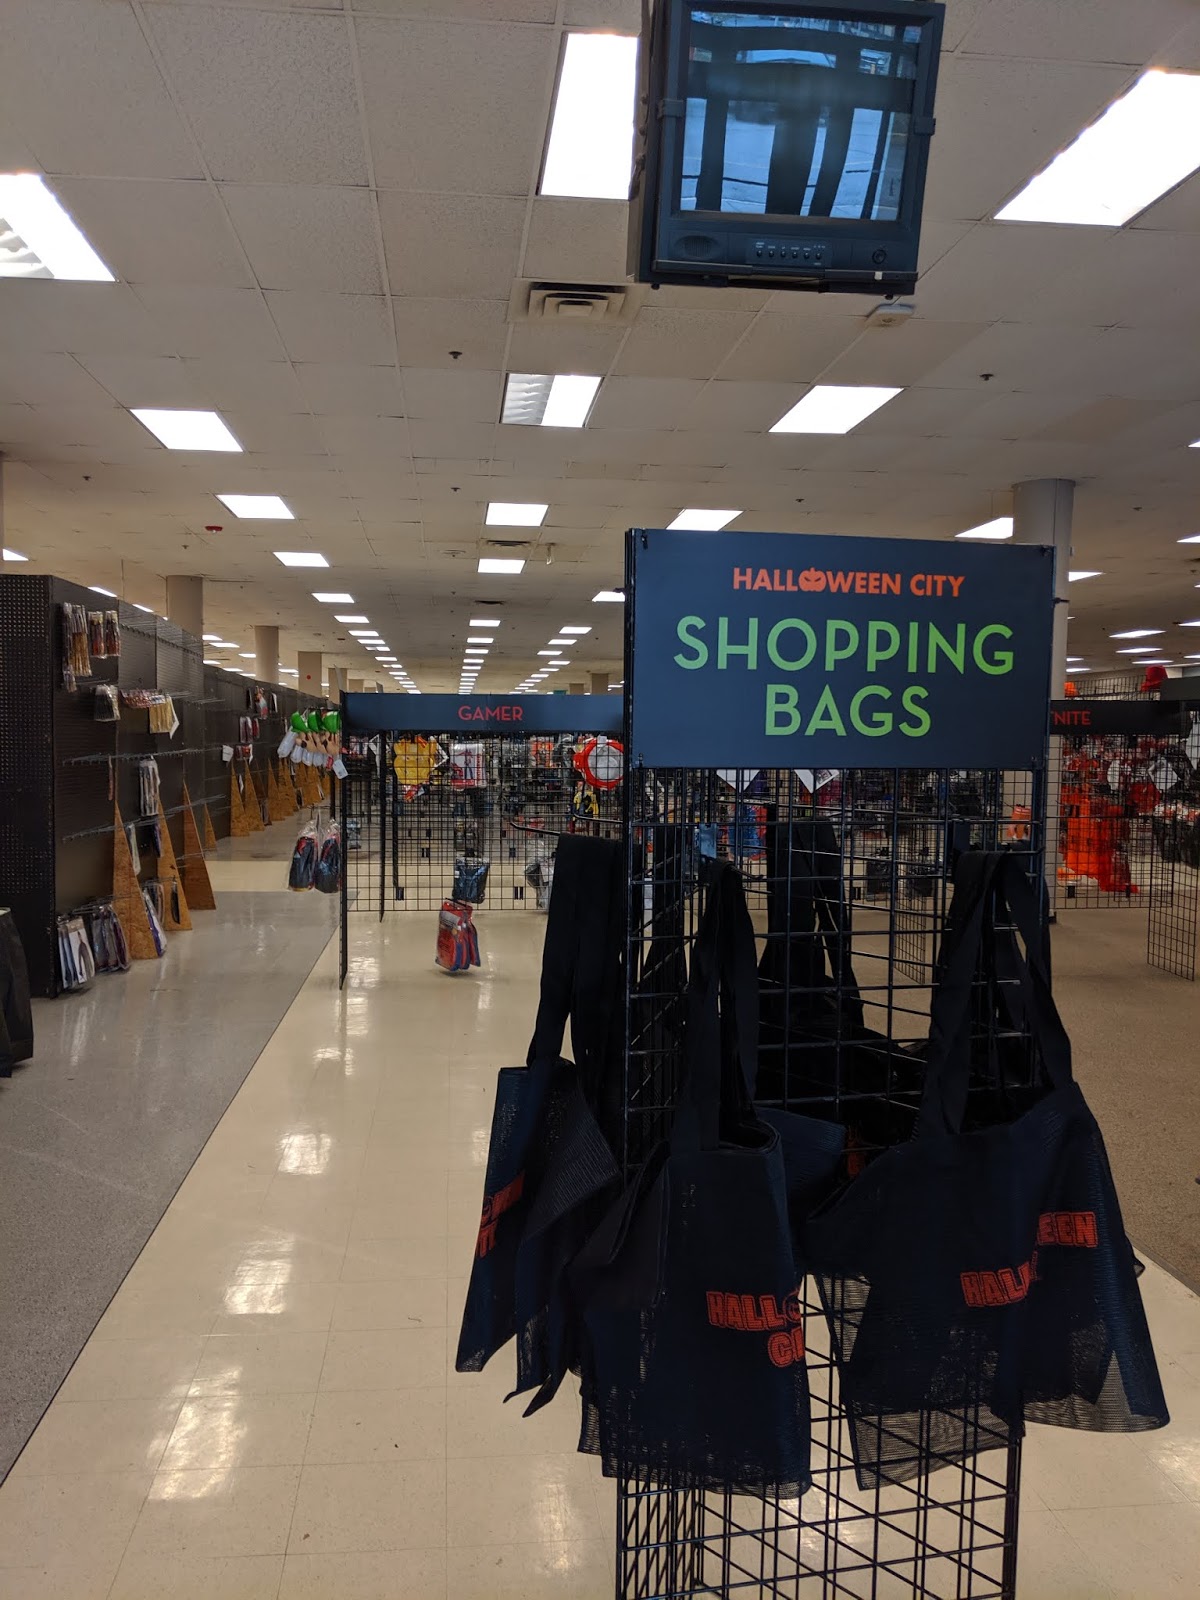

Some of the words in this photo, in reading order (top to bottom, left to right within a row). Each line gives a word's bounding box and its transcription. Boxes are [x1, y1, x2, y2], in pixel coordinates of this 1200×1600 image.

[733, 567, 901, 595] HALLOWEEN
[909, 573, 965, 597] CITY
[673, 615, 1014, 675] SHOPPING
[458, 705, 523, 720] GAMER
[765, 684, 931, 737] BAGS
[1051, 710, 1091, 725] NITE
